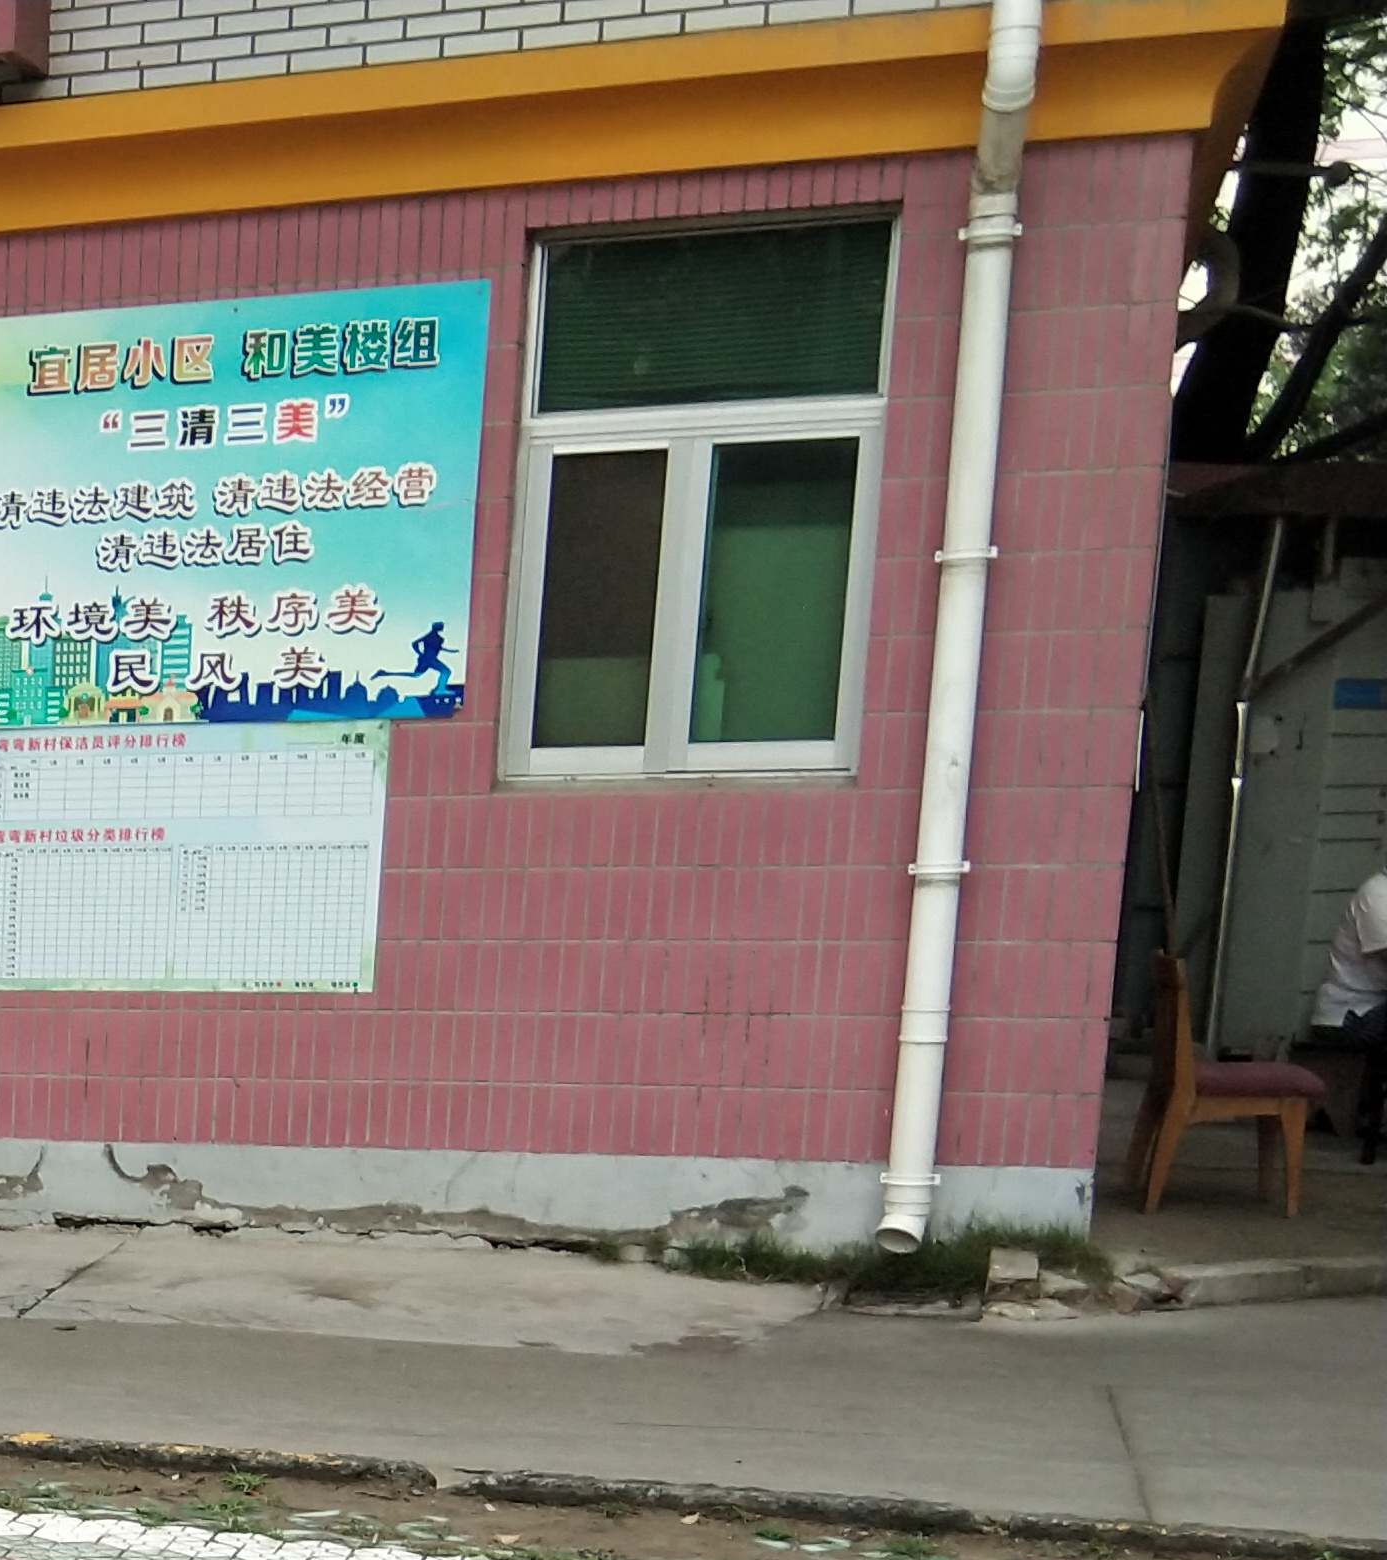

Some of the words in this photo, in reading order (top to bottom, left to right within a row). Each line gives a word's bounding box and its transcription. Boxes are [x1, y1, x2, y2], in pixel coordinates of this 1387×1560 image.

[30, 335, 215, 394] 宜居小区
[245, 317, 440, 379] 和美楼组
[99, 397, 349, 449] “三清三美”
[215, 465, 435, 513] 清违法经营
[98, 526, 313, 570] 清违法居住
[10, 600, 175, 642] 环境美
[206, 588, 384, 634] 秩序美
